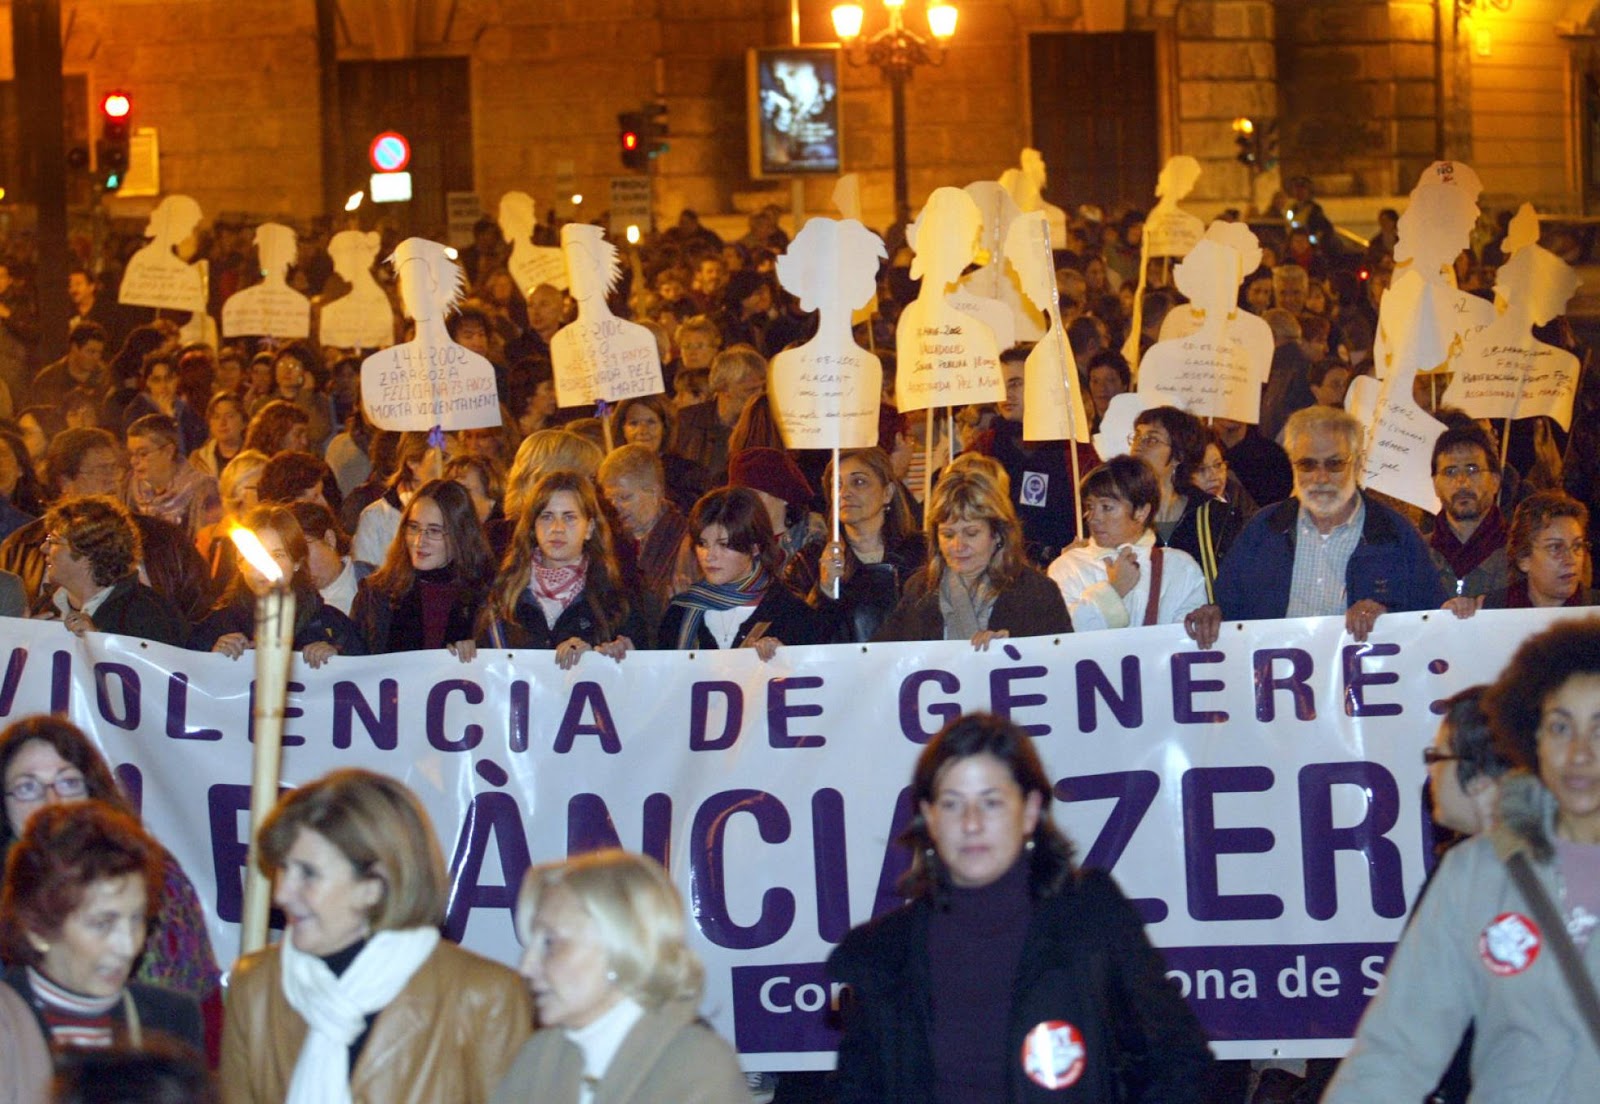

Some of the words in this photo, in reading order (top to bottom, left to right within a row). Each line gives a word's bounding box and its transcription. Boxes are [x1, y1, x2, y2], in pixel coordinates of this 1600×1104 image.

[379, 367, 460, 387] ZARAGOZA
[369, 401, 414, 420] MORTA
[417, 393, 498, 415] VIOLENTAMENT
[689, 676, 827, 752] DE
[1053, 761, 1438, 924] ZER
[1277, 955, 1341, 998] de
